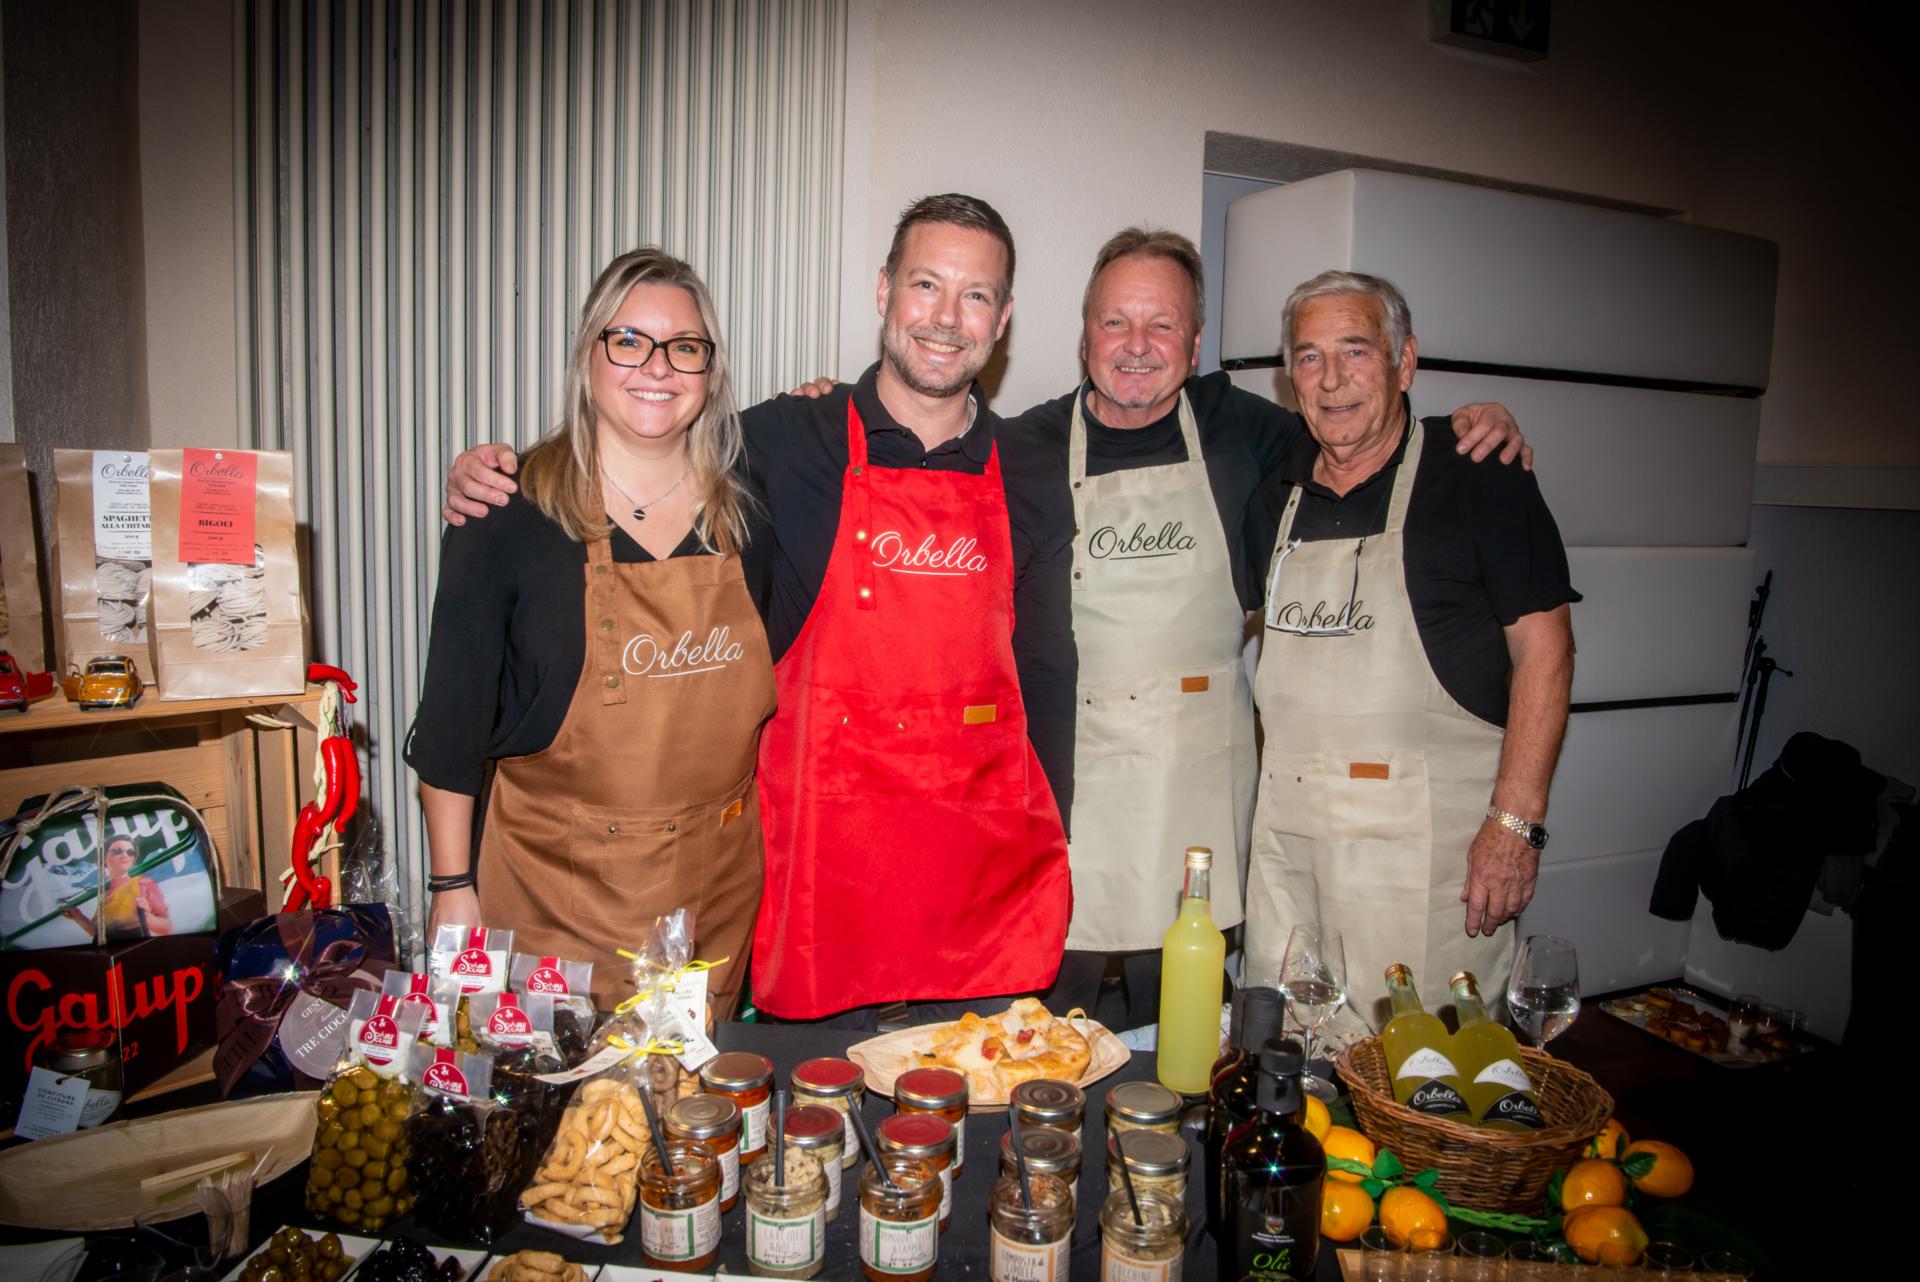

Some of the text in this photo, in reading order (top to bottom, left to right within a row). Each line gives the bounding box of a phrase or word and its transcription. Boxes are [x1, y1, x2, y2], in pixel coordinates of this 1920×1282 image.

[190, 461, 246, 480] Orbella
[871, 531, 988, 573] Orbella
[1089, 521, 1197, 559] Orbella
[1277, 600, 1375, 633] Orbella
[622, 626, 743, 676] Orbella
[7, 961, 204, 1074] Galup
[295, 1036, 320, 1059] TRE
[38, 1087, 75, 1101] CONFITURE
[1413, 1087, 1462, 1105] Orbella
[1001, 1249, 1038, 1267] COMPOSTA
